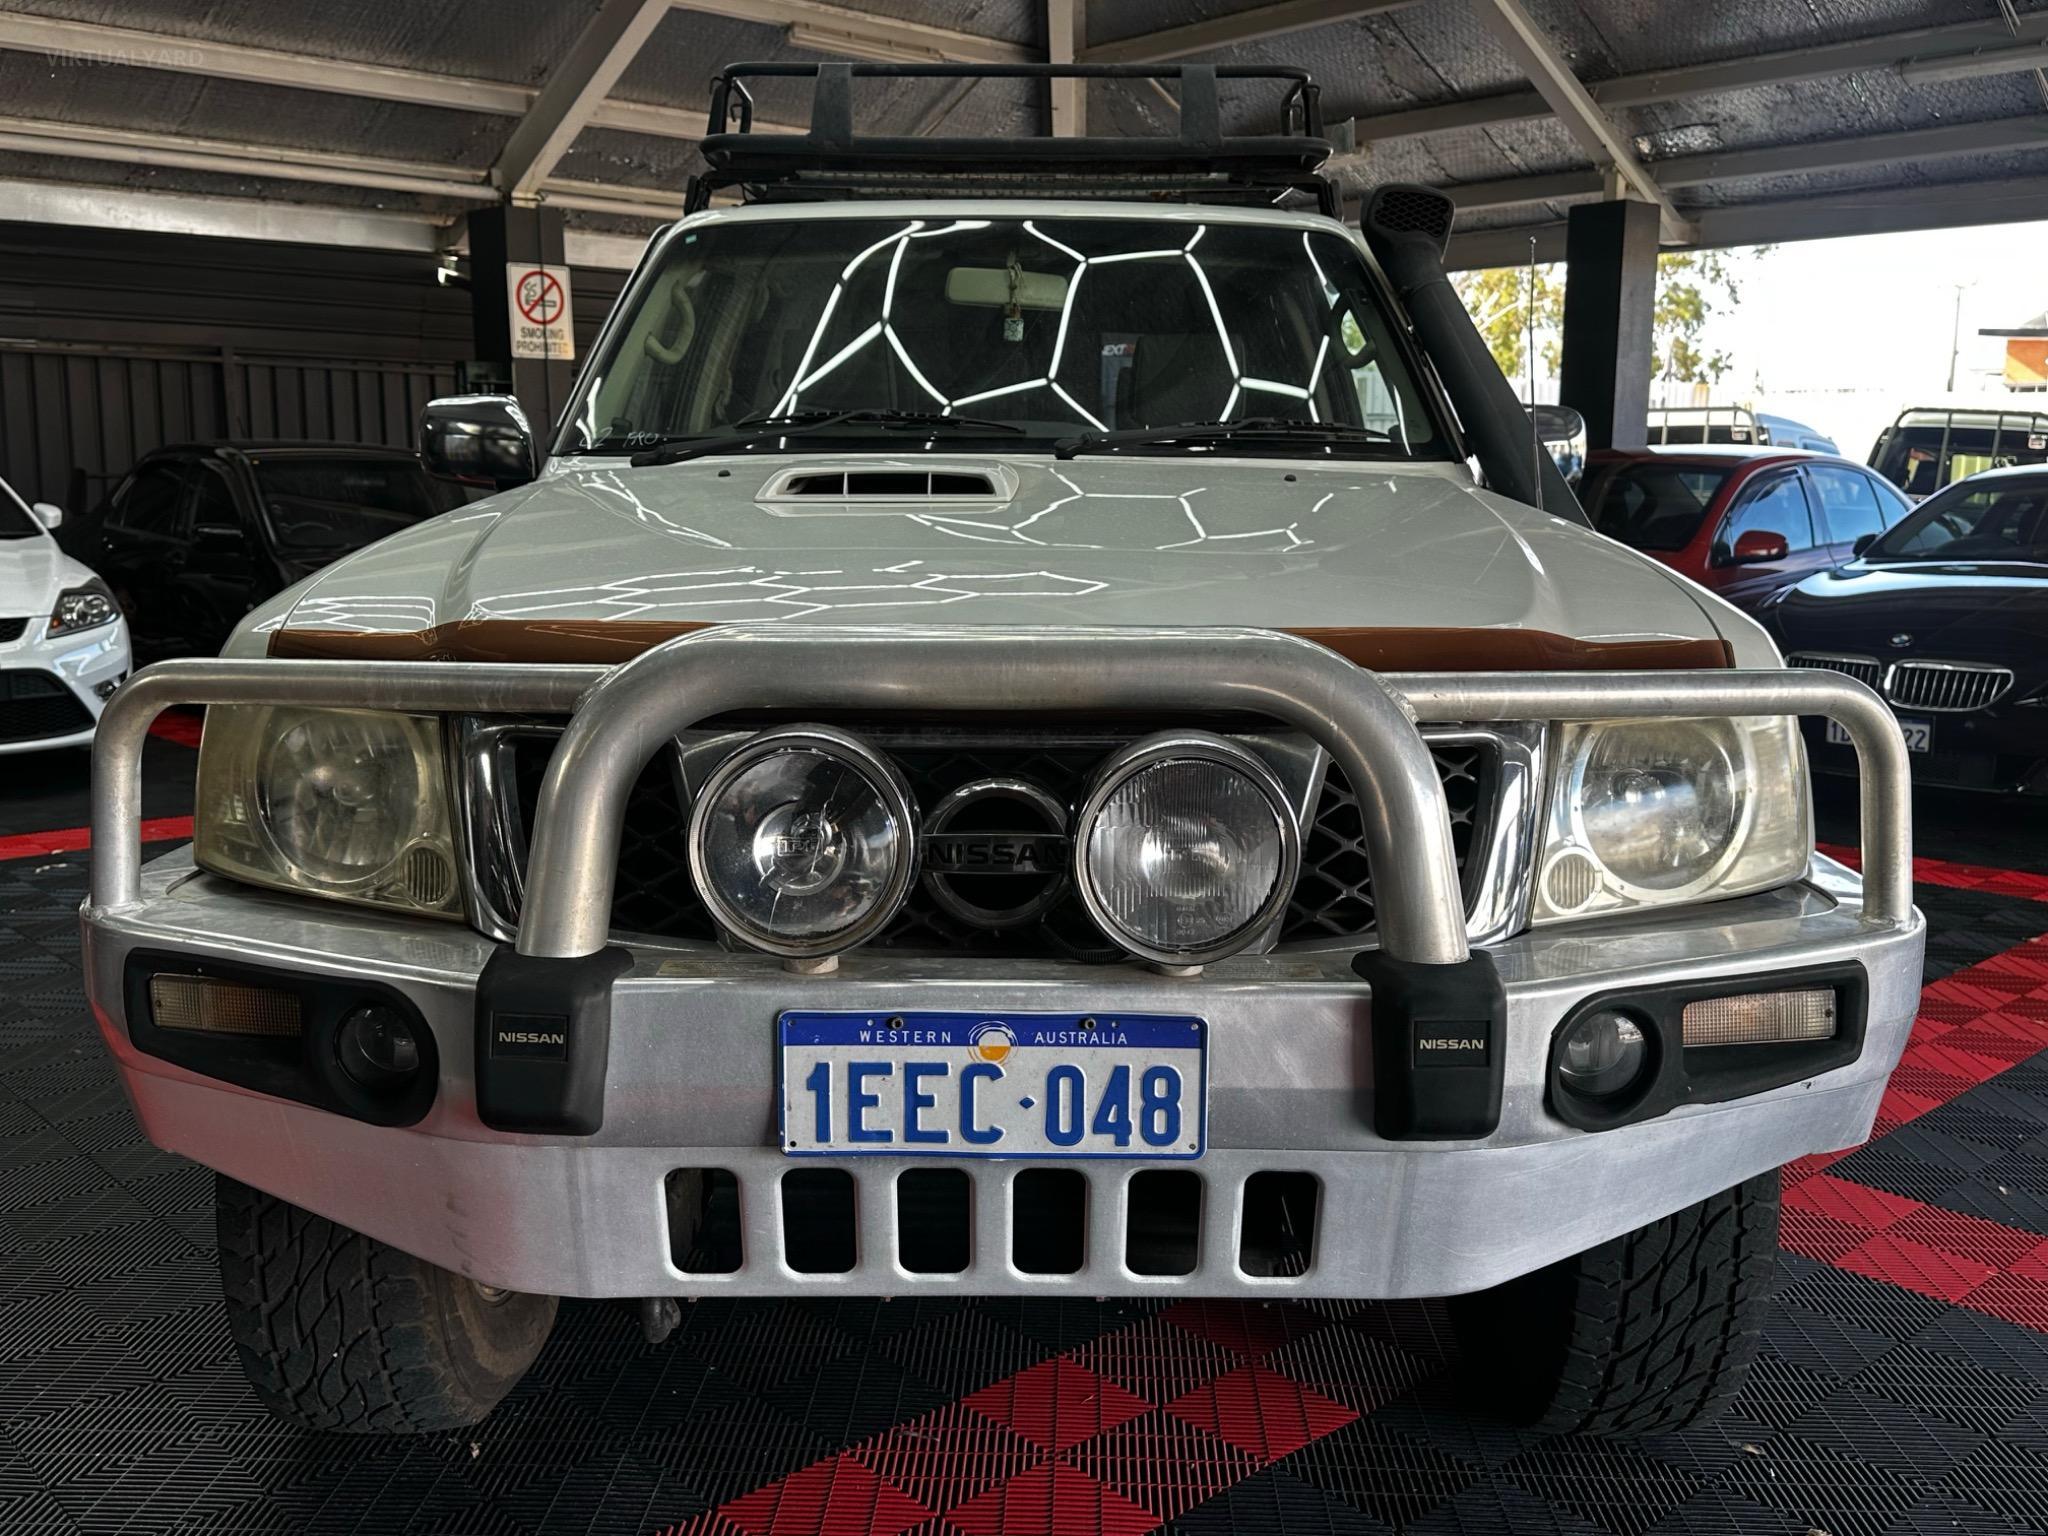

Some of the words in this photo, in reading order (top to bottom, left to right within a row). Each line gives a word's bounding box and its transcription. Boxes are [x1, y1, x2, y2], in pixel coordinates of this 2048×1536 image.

[520, 326, 565, 340] SMOING
[928, 842, 1066, 865] NISSAN
[498, 1032, 565, 1045] NISSAN
[859, 1030, 951, 1043] WESTERN
[1034, 1031, 1128, 1045] AUSTRALIA
[1419, 1039, 1485, 1050] NISSAN
